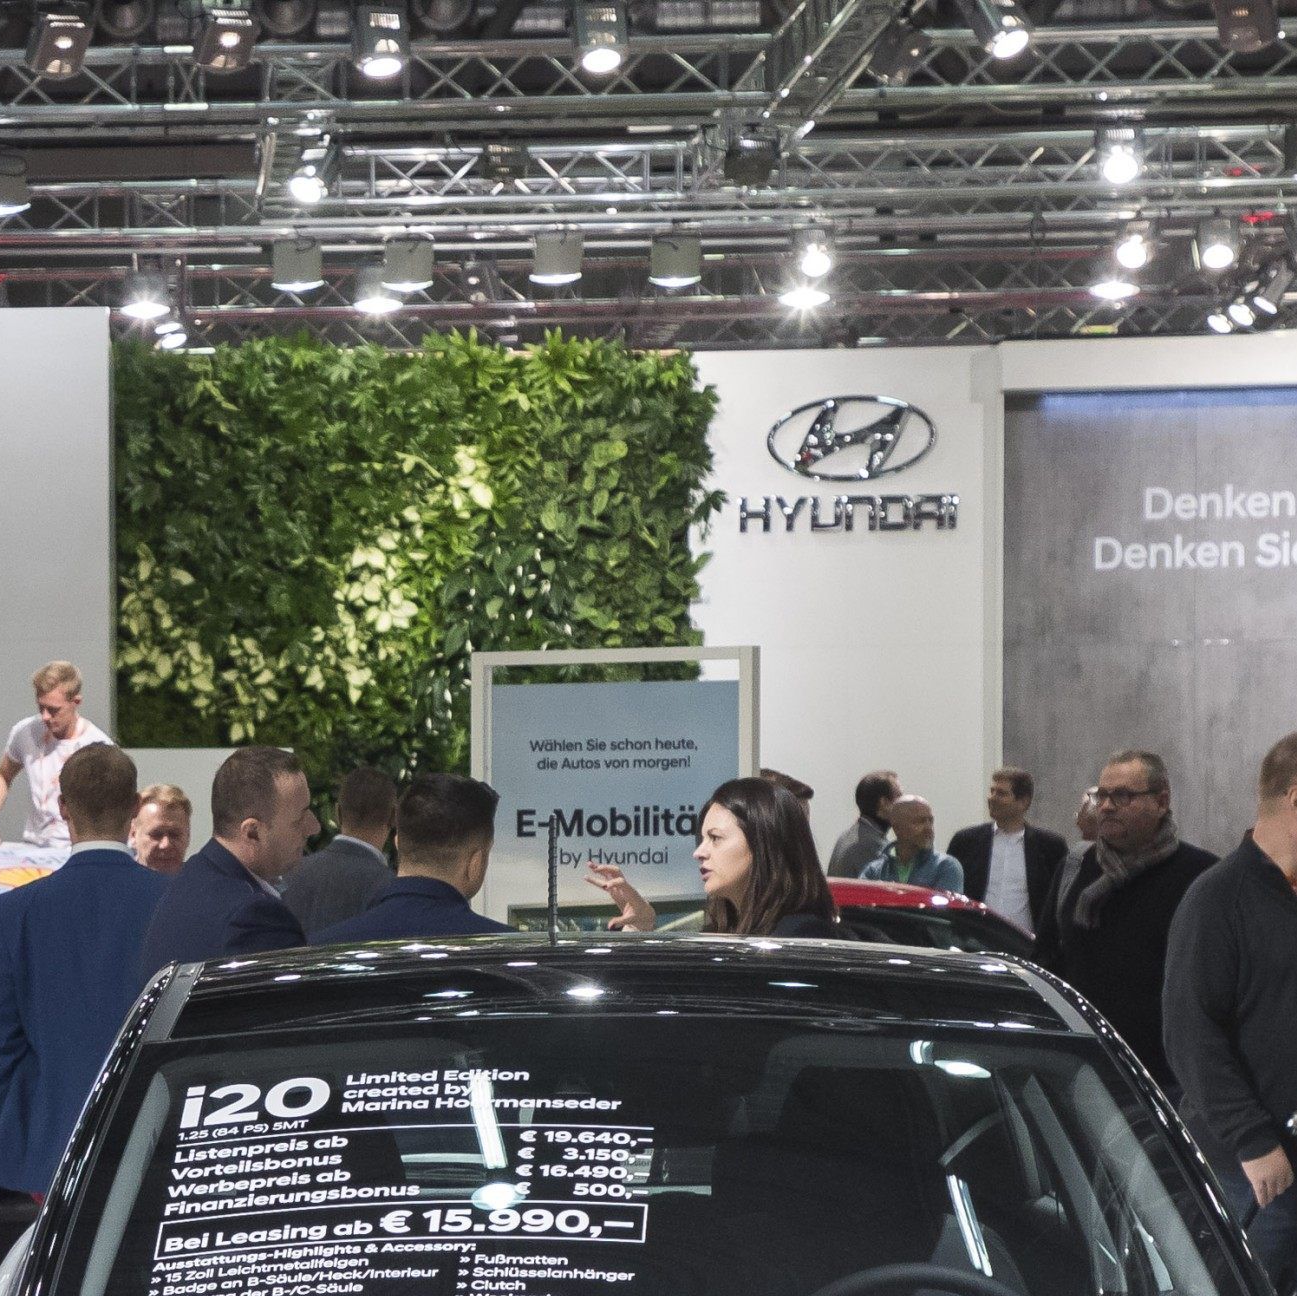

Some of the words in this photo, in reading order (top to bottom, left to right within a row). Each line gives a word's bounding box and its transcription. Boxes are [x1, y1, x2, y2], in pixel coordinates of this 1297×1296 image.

[739, 494, 960, 533] HYUNDAI
[1144, 484, 1297, 520] Denken
[1094, 534, 1245, 570] Denken
[1256, 530, 1297, 568] Si
[529, 738, 582, 752] Wählen
[586, 738, 606, 751] Sie
[610, 737, 651, 751] schon
[655, 737, 698, 752] heute,
[537, 757, 558, 770] die
[561, 757, 600, 770] Autos
[605, 759, 629, 769] von
[633, 755, 691, 772] morgen!
[516, 805, 698, 838] E-Mobilitä
[560, 847, 582, 869] by
[588, 846, 669, 865] Hyundai
[343, 1083, 440, 1099] created
[444, 1082, 473, 1097] by
[346, 1070, 438, 1086] Limited
[443, 1068, 530, 1082] Edition
[180, 1077, 330, 1129] i20
[341, 1097, 431, 1113] Marina
[178, 1129, 209, 1141] 1.25
[212, 1127, 239, 1138] (84
[243, 1123, 269, 1135] PS)
[272, 1119, 309, 1131] 5MT
[174, 1138, 309, 1163] Listenpreis
[313, 1135, 349, 1149] ab
[171, 1154, 343, 1180] Vorteilsbonus
[167, 1171, 311, 1198] Werbepreis
[315, 1168, 352, 1182] ab
[164, 1184, 420, 1216] Finanzierungsbonus
[164, 1231, 209, 1252] Bei
[215, 1222, 328, 1247] Leasing
[333, 1220, 373, 1235] ab
[380, 1209, 413, 1233] €
[152, 1242, 362, 1273] Ausstattungs-Highlights
[364, 1243, 378, 1254] &
[380, 1240, 477, 1254] Accessory:
[164, 1271, 183, 1284] 15
[184, 1268, 215, 1282] Zoll
[217, 1256, 369, 1279] Leichtmetallfelgen
[474, 1254, 569, 1265] Fußmatten
[162, 1281, 217, 1296] Badge
[221, 1278, 243, 1289] an
[247, 1267, 439, 1287] B-Säule/Heck/Interieur
[470, 1280, 526, 1291] Clutch
[472, 1266, 635, 1282] Schlüsselanhänger
